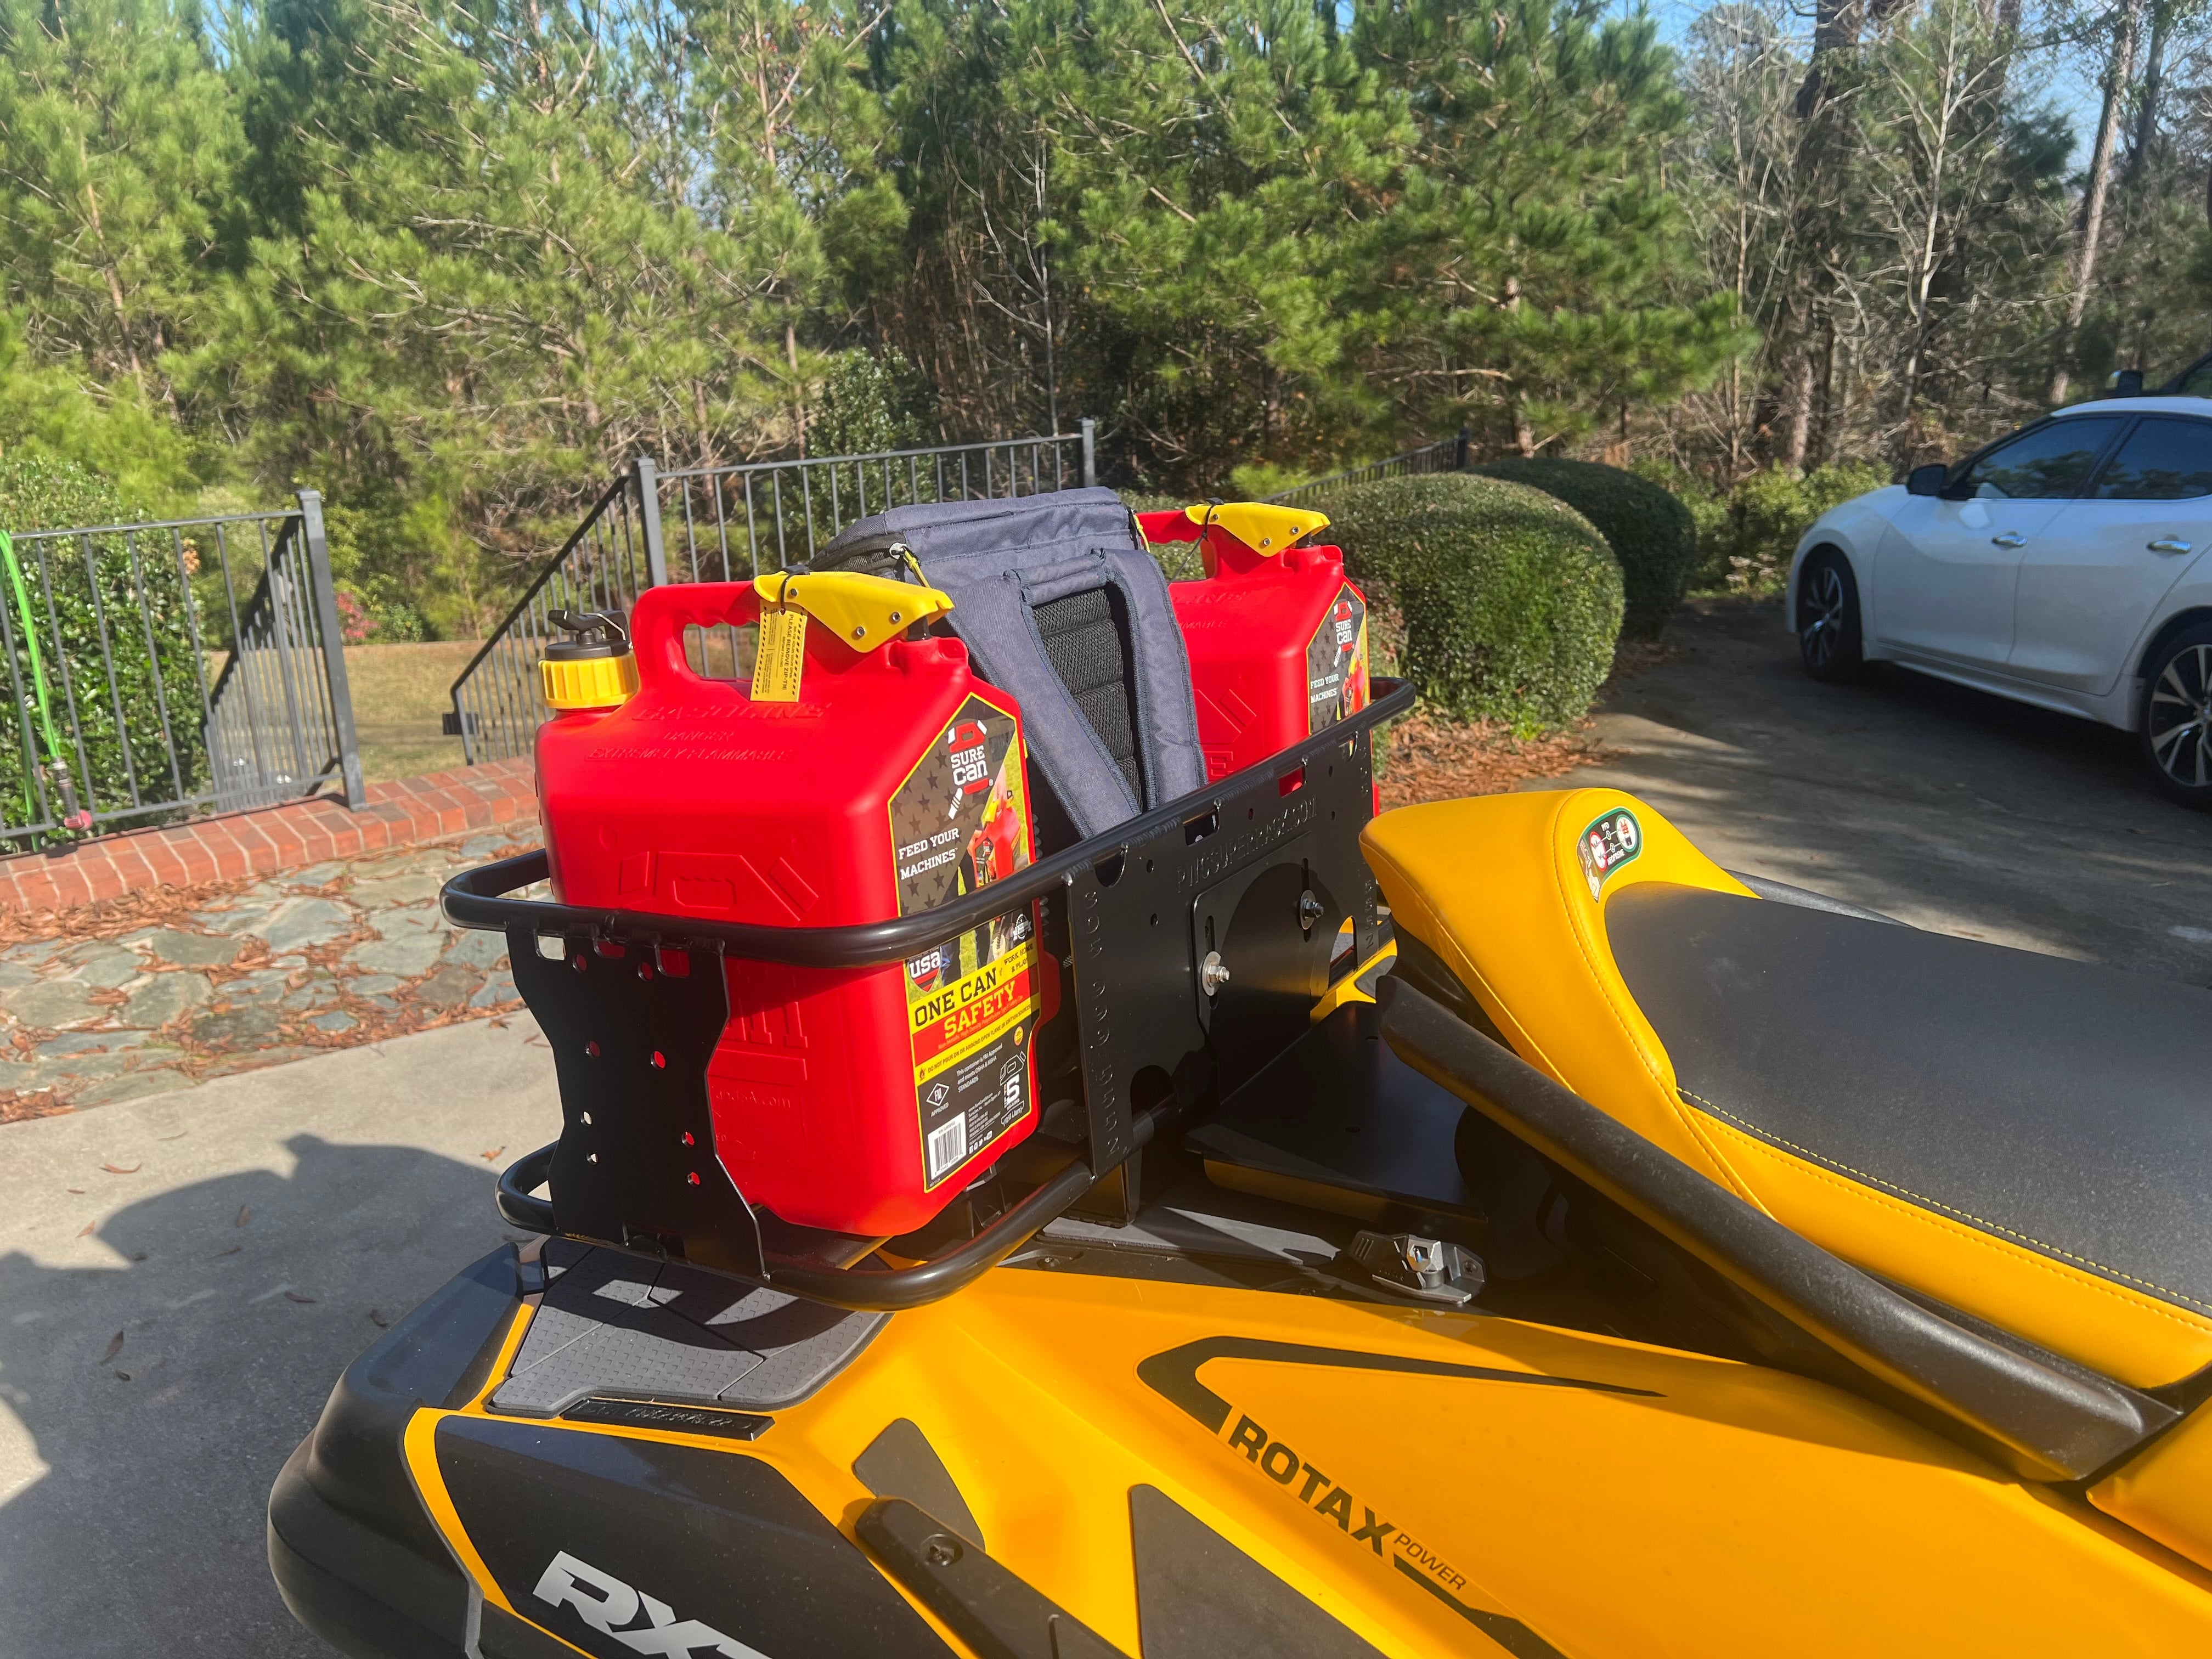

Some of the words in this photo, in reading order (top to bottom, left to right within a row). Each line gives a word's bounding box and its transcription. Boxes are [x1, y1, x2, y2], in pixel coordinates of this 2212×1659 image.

[1335, 619, 1351, 632] SURE
[1311, 679, 1324, 690] FEED
[1325, 673, 1339, 685] YOUR
[1311, 687, 1337, 703] MACHINES
[951, 745, 985, 768] SURE
[898, 839, 928, 860] FEED
[929, 828, 960, 848] YOUR
[900, 851, 957, 881] MACHINES
[1020, 943, 1033, 956] HOME
[1011, 964, 1015, 973] &
[1015, 957, 1028, 969] PLAY
[915, 989, 955, 1026] ONE
[961, 967, 996, 1002] CAN
[944, 980, 1015, 1040] SAFETY
[928, 1064, 934, 1073] DO
[934, 1059, 942, 1070] NOT
[943, 1053, 953, 1065] POUR
[953, 1049, 960, 1058] ON
[960, 1046, 966, 1055] OR
[966, 1037, 980, 1051] AROUND
[980, 1031, 990, 1042] OPEN
[990, 1025, 1001, 1036] FLAME
[963, 1057, 980, 1073] container
[988, 1042, 1003, 1058] Approved
[934, 1087, 942, 1101] FM
[958, 1075, 979, 1093] STANDARDS
[1006, 1073, 1020, 1106] 5
[930, 1102, 949, 1118] APPROVED
[1228, 1414, 1396, 1558] ROTAX
[1393, 1533, 1466, 1590] POWER
[533, 1550, 774, 1659] RX
